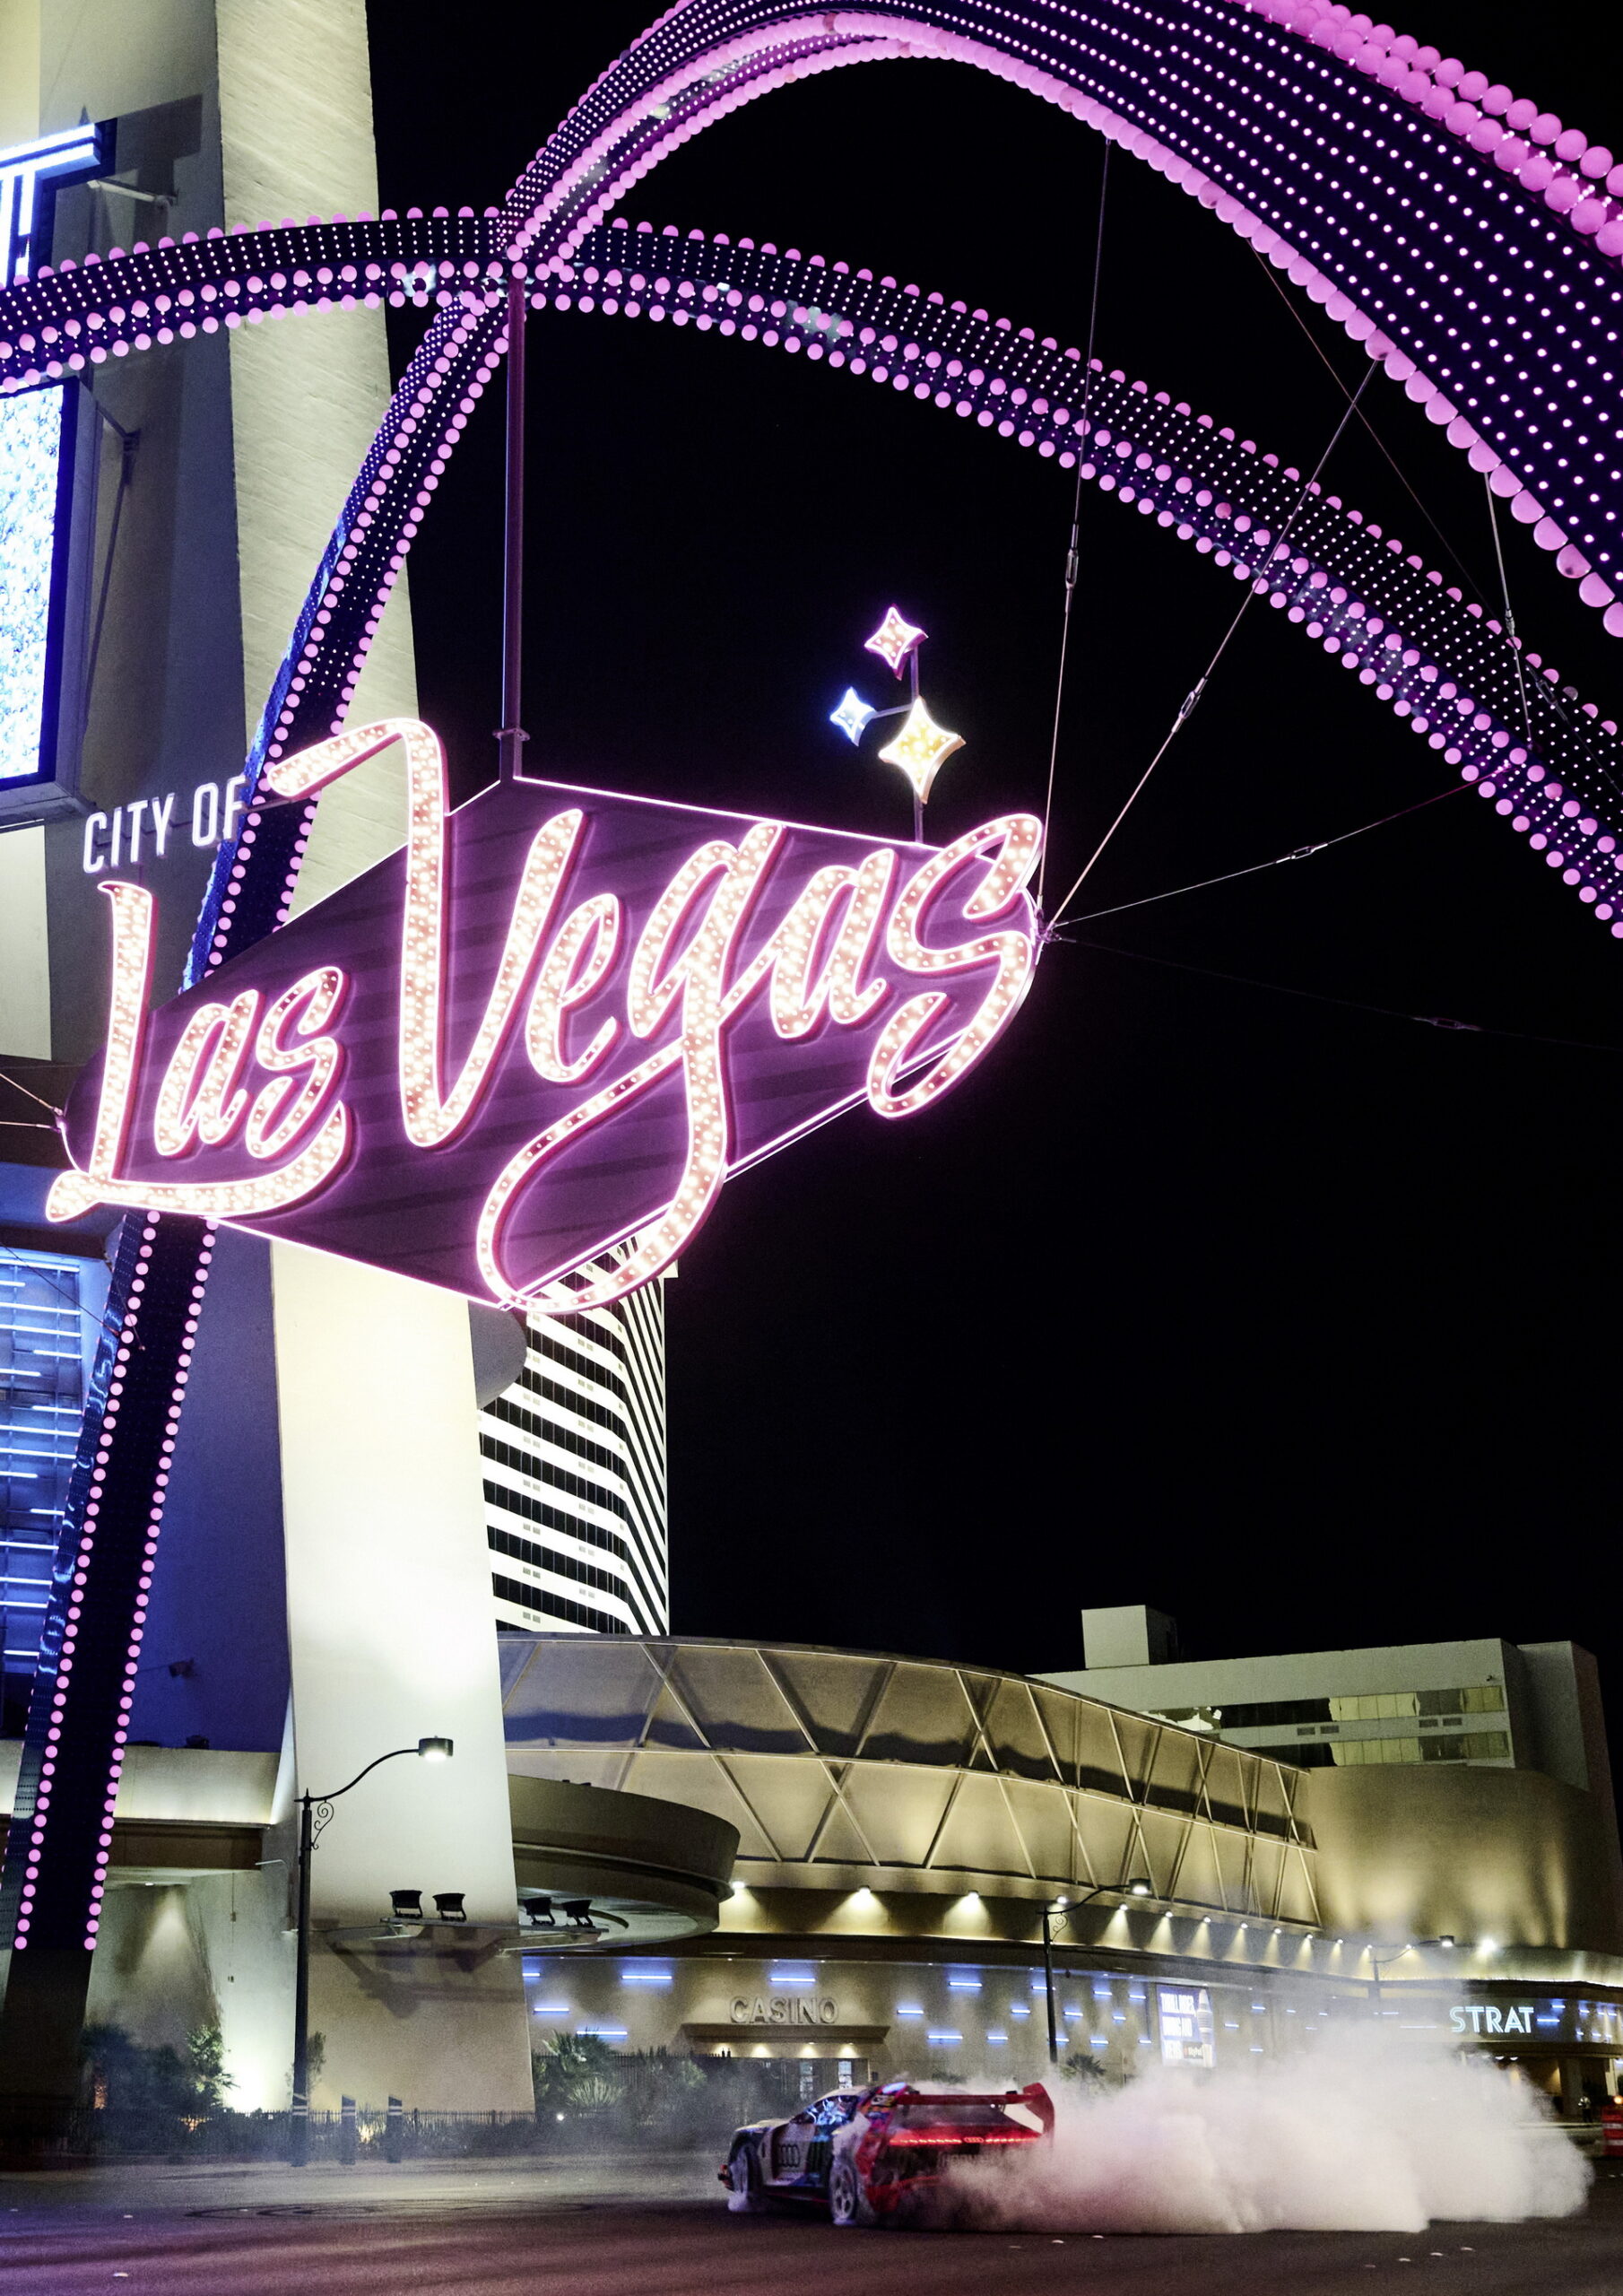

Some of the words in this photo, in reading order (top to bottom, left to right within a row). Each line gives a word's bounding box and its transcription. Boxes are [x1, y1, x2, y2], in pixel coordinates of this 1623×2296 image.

[83, 793, 175, 874] CITY
[192, 775, 247, 848] OF
[45, 881, 351, 1222] Las
[267, 718, 1042, 1314] Vegas
[730, 1996, 839, 2024] CASINO
[1449, 2005, 1534, 2033] STRAT
